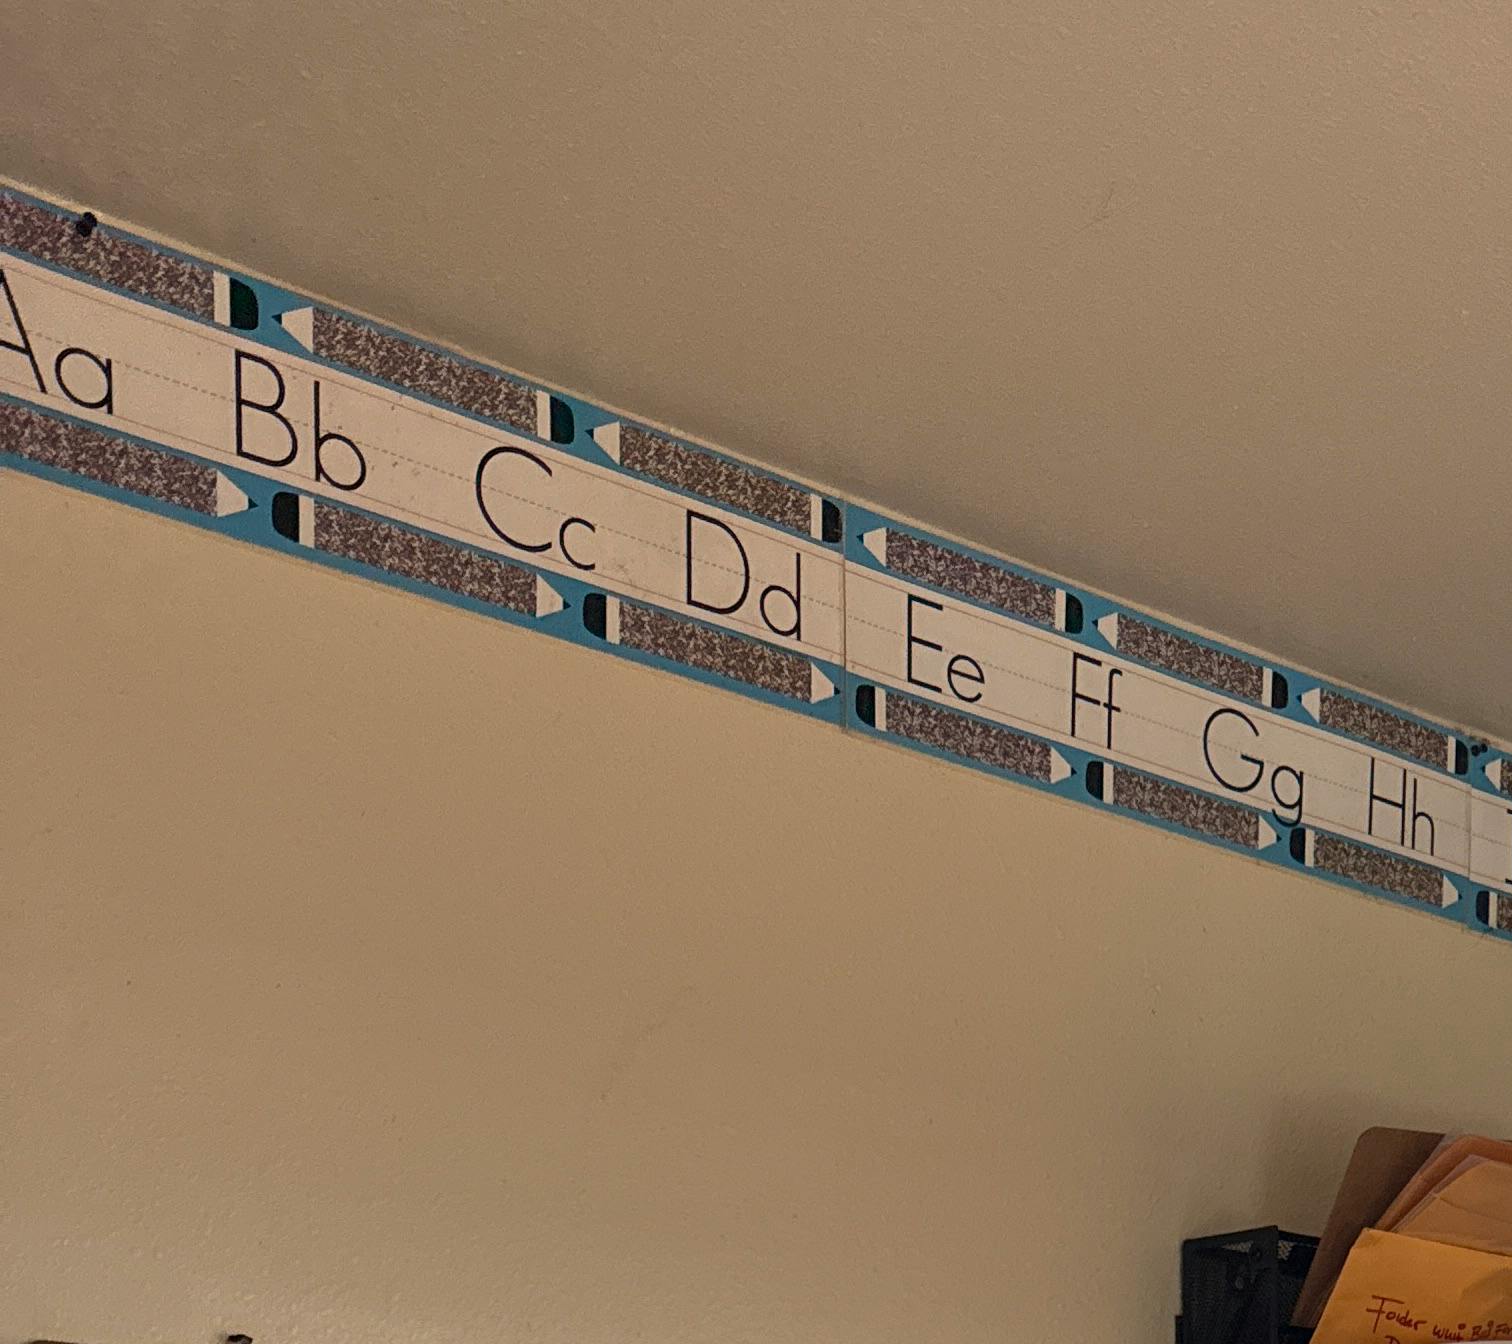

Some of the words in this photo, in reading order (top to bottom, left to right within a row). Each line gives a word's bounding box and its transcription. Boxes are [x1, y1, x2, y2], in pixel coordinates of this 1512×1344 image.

[234, 349, 368, 491] Bb
[475, 445, 596, 572] Cc
[686, 509, 802, 641] Dd
[906, 594, 985, 703] Ee
[1071, 652, 1122, 750] Ff
[1202, 708, 1304, 827] Gg
[1369, 756, 1435, 856] Hh
